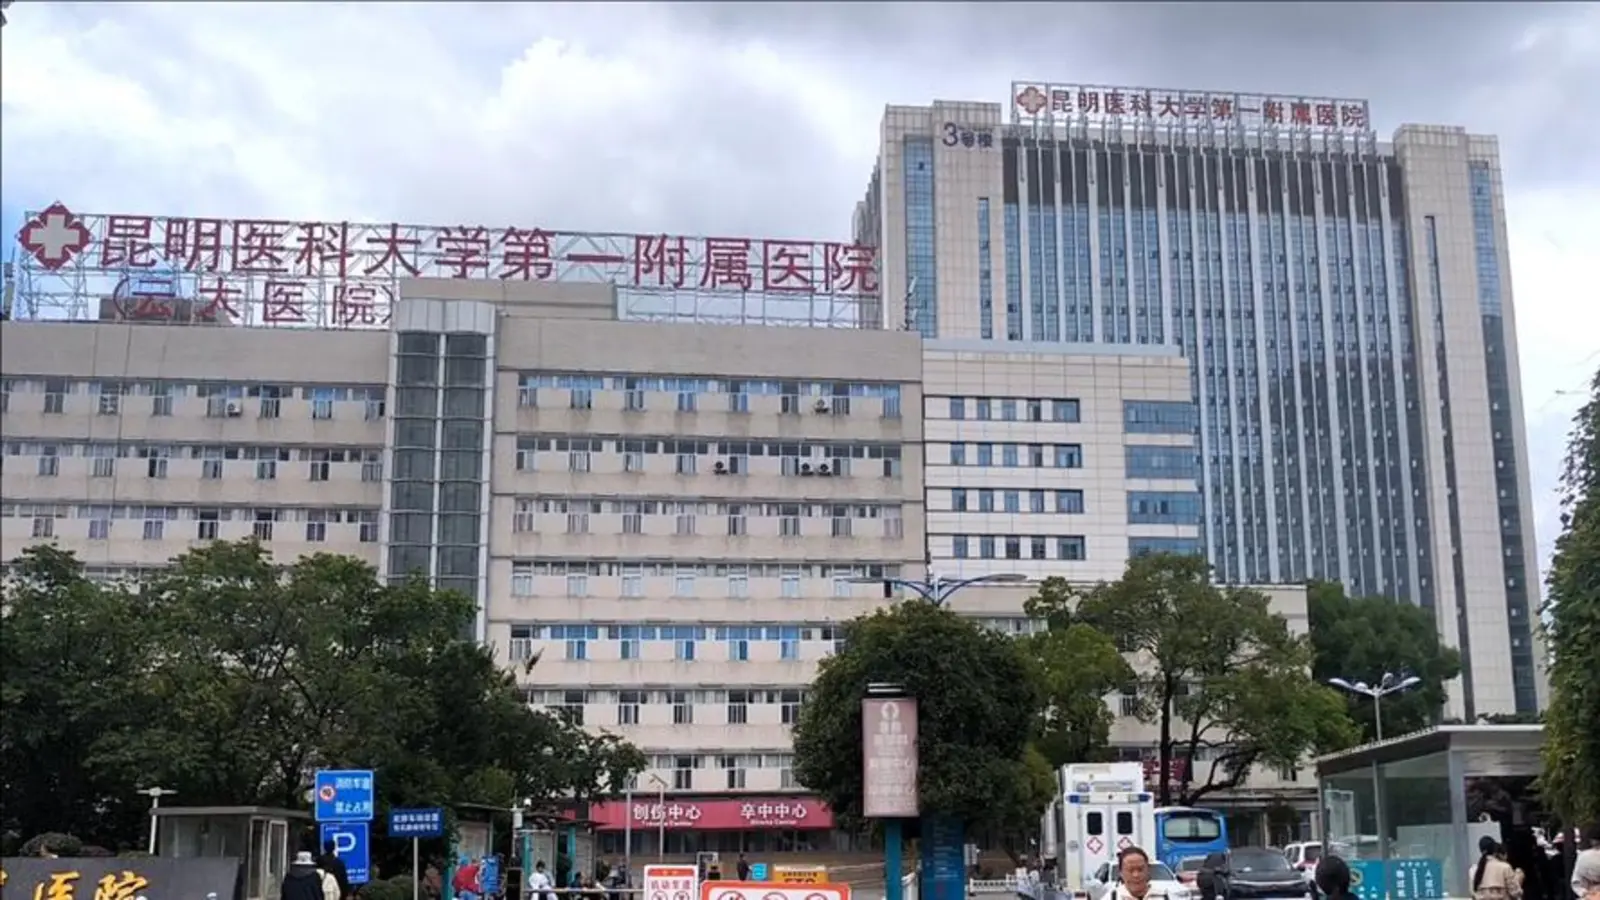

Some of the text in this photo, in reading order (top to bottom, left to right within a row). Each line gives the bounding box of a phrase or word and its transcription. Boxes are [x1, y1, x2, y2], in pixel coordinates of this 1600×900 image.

[1051, 88, 1364, 128] 昆明医科大学第一附属医院
[942, 122, 993, 149] 3号楼
[101, 214, 879, 294] 昆明医科大学第一附属医院
[633, 803, 702, 820] 创伤中心
[740, 802, 808, 820] 卒中中心
[332, 832, 357, 855] P
[0, 870, 148, 900] 医院
